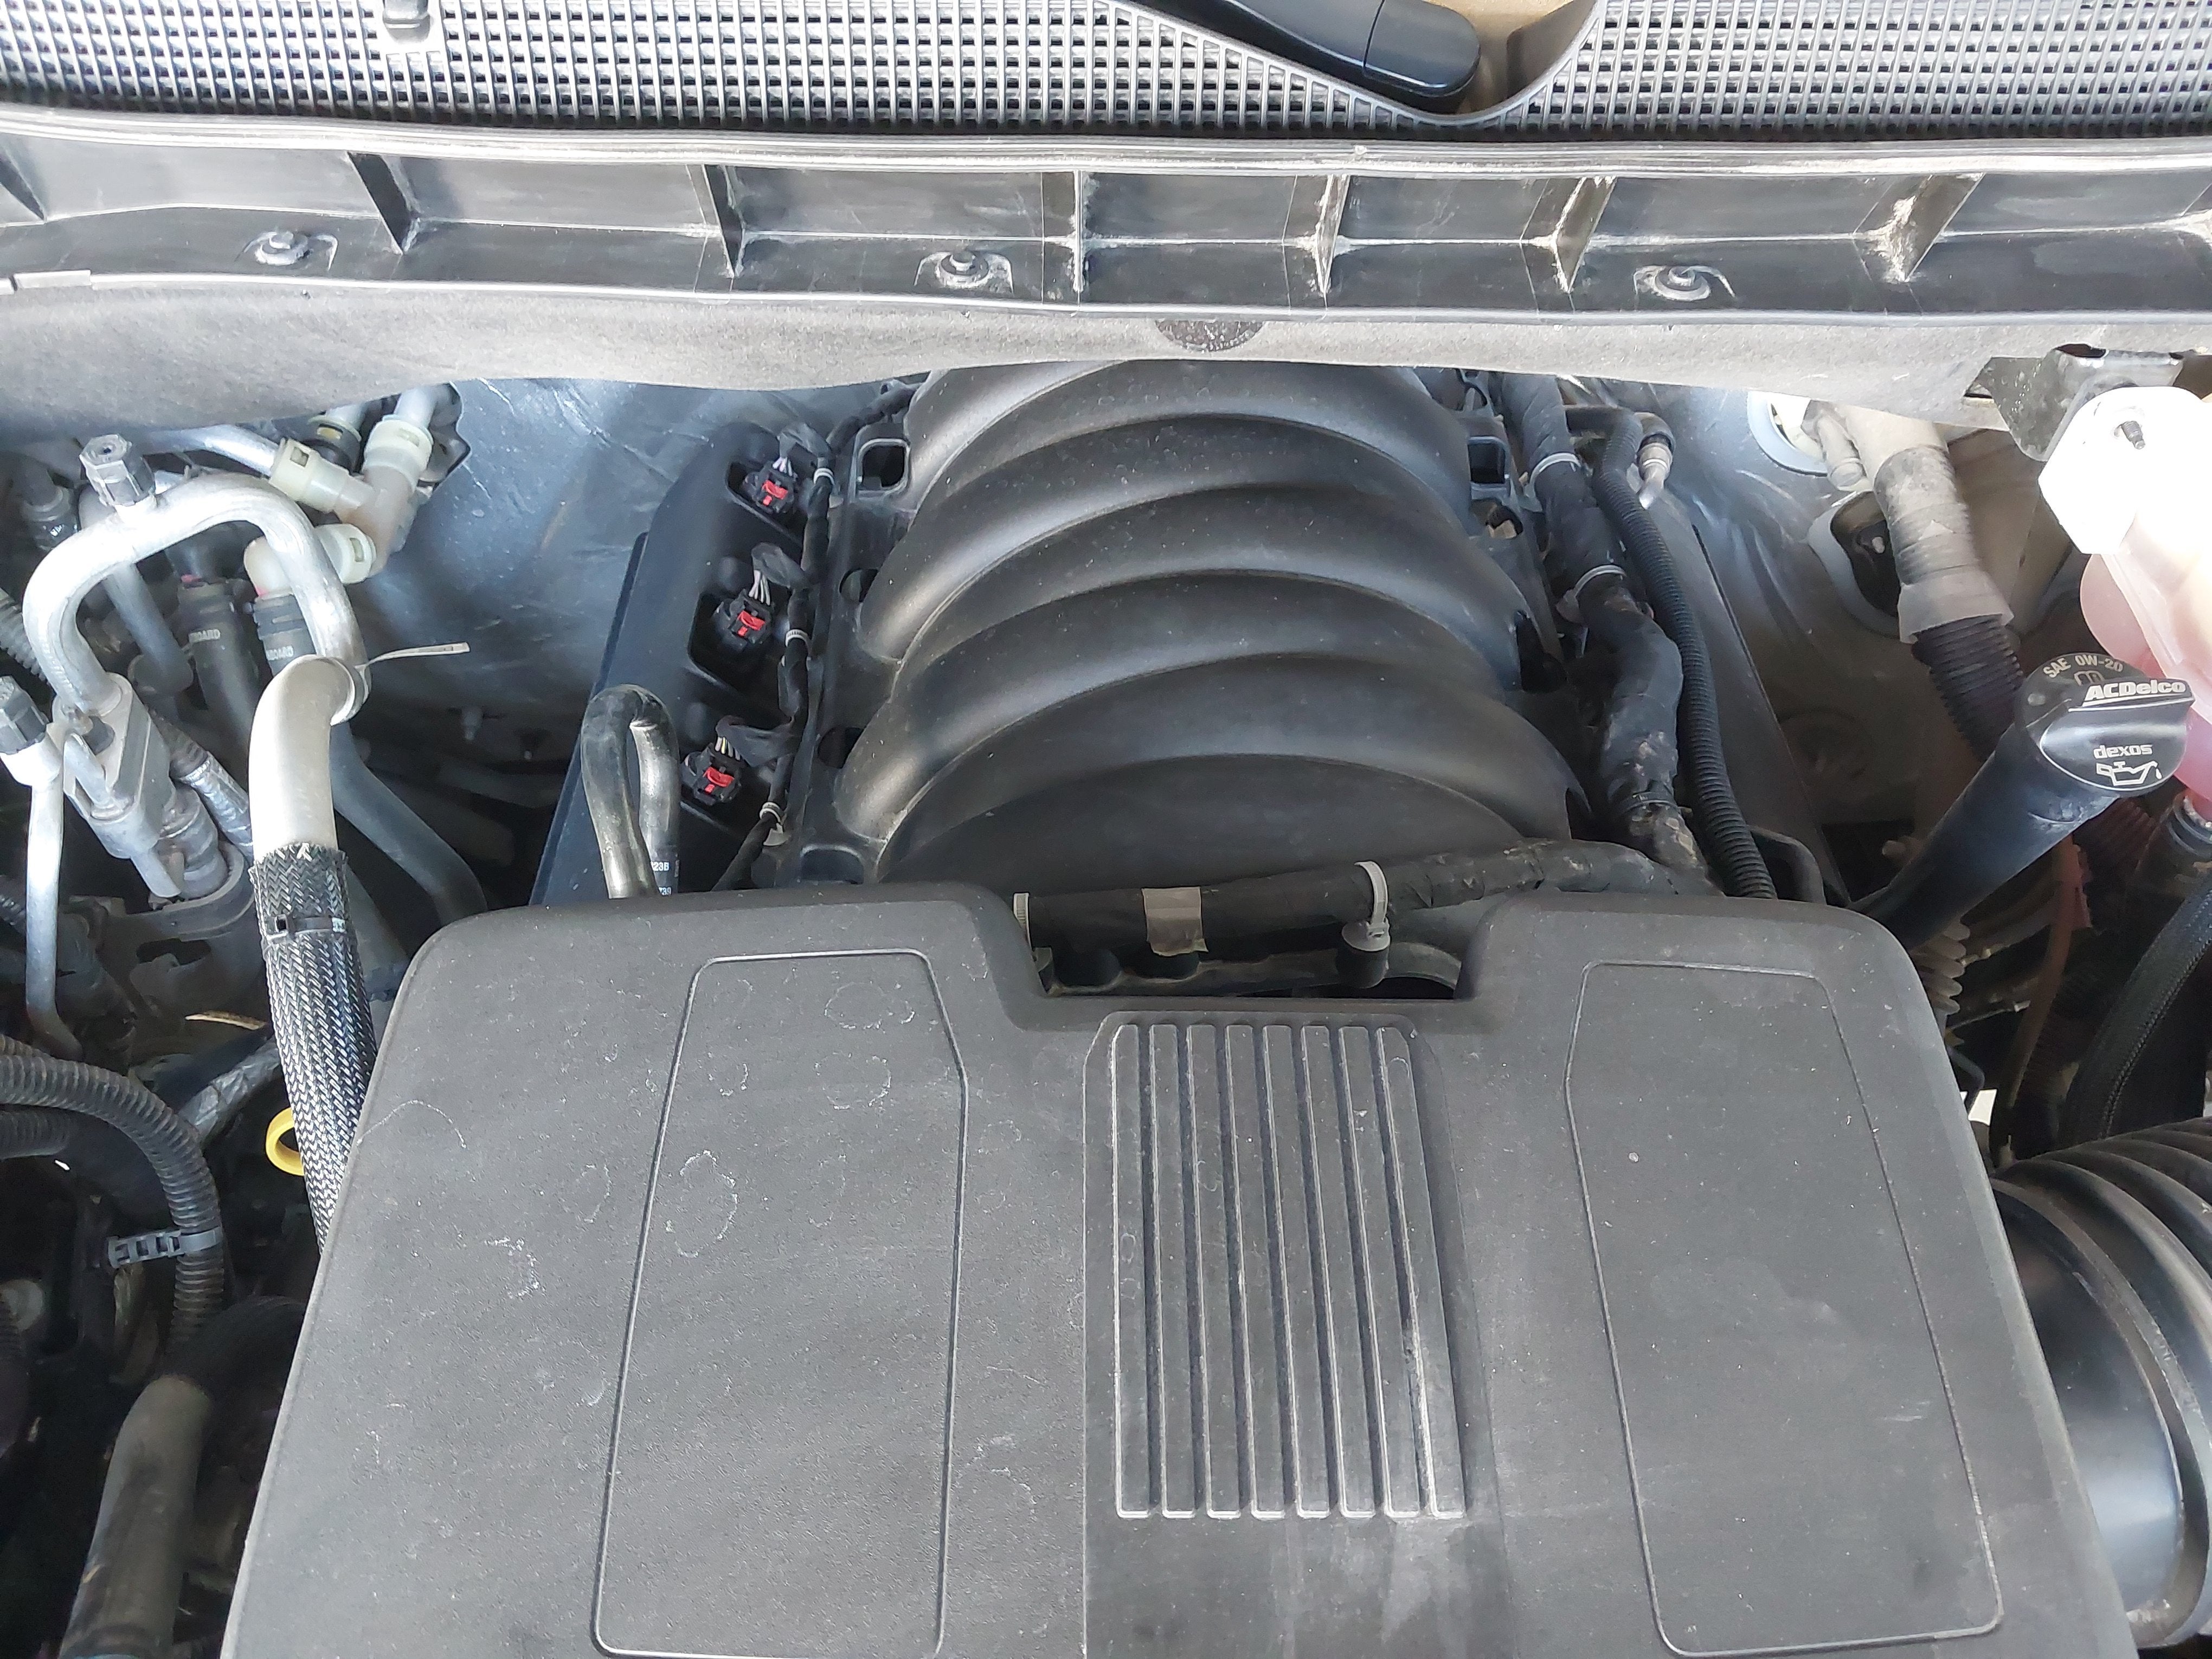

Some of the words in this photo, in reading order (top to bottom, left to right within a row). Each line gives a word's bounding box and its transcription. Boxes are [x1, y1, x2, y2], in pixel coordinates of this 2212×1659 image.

[2043, 658, 2072, 678] SAE
[2075, 654, 2124, 672] 0W-20
[2084, 679, 2187, 701] ACDelco
[2093, 744, 2153, 758] dexos
